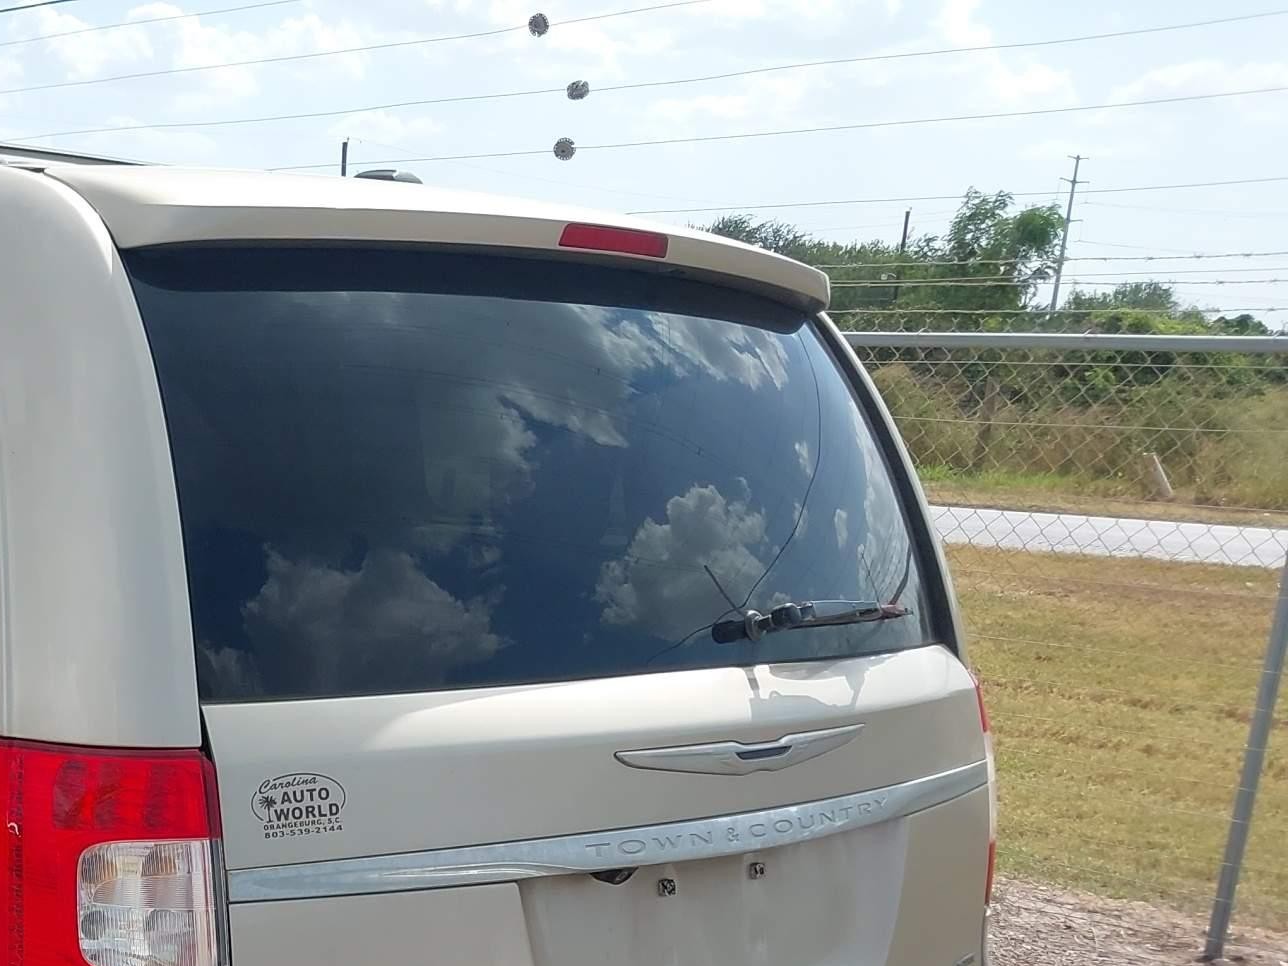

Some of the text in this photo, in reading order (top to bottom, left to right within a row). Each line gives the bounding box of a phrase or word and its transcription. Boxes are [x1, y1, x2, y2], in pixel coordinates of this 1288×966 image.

[258, 776, 318, 794] Carolina
[280, 787, 330, 805] AUTO
[273, 803, 340, 822] WORLD
[264, 824, 343, 839] 803-539-2144
[584, 795, 889, 858] TOWN & COUNTRY
